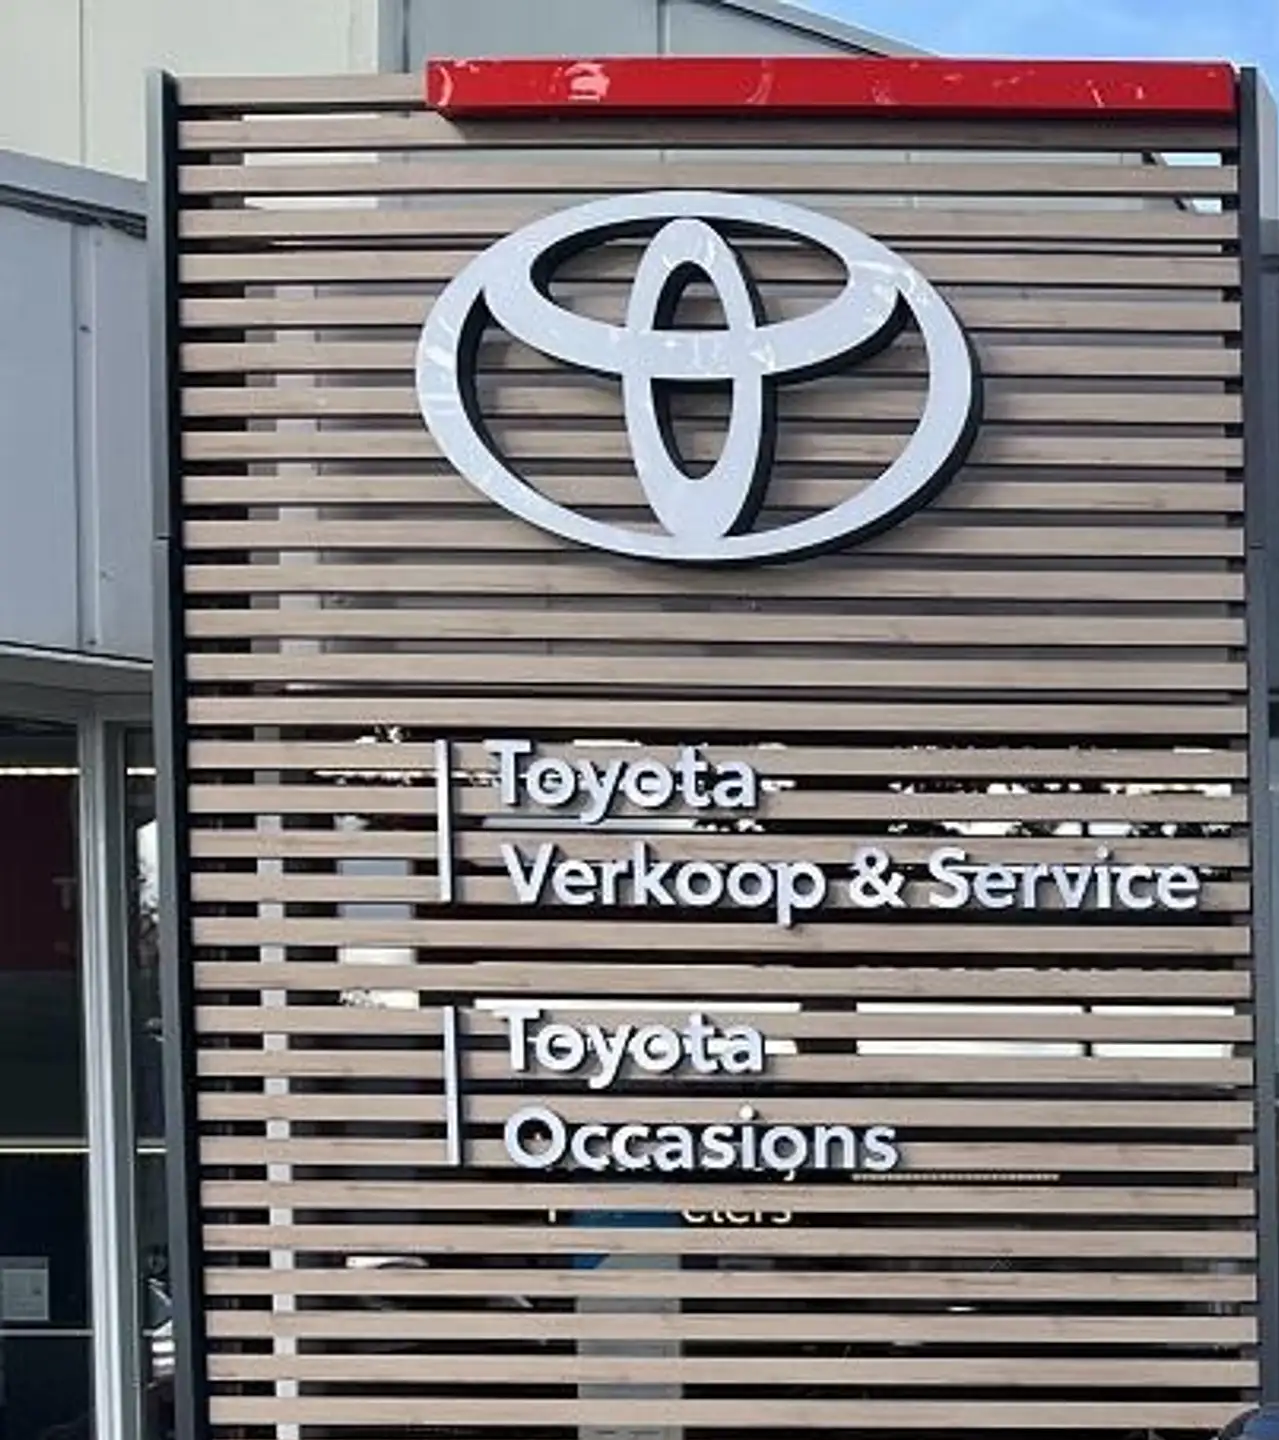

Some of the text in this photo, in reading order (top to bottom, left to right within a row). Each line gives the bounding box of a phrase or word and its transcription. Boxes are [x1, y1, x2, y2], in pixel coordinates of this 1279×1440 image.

[483, 739, 756, 825] Toyota
[501, 841, 1201, 926] Verkoop & Service
[494, 1007, 764, 1089] Toyota
[504, 1104, 898, 1171] Occasions
